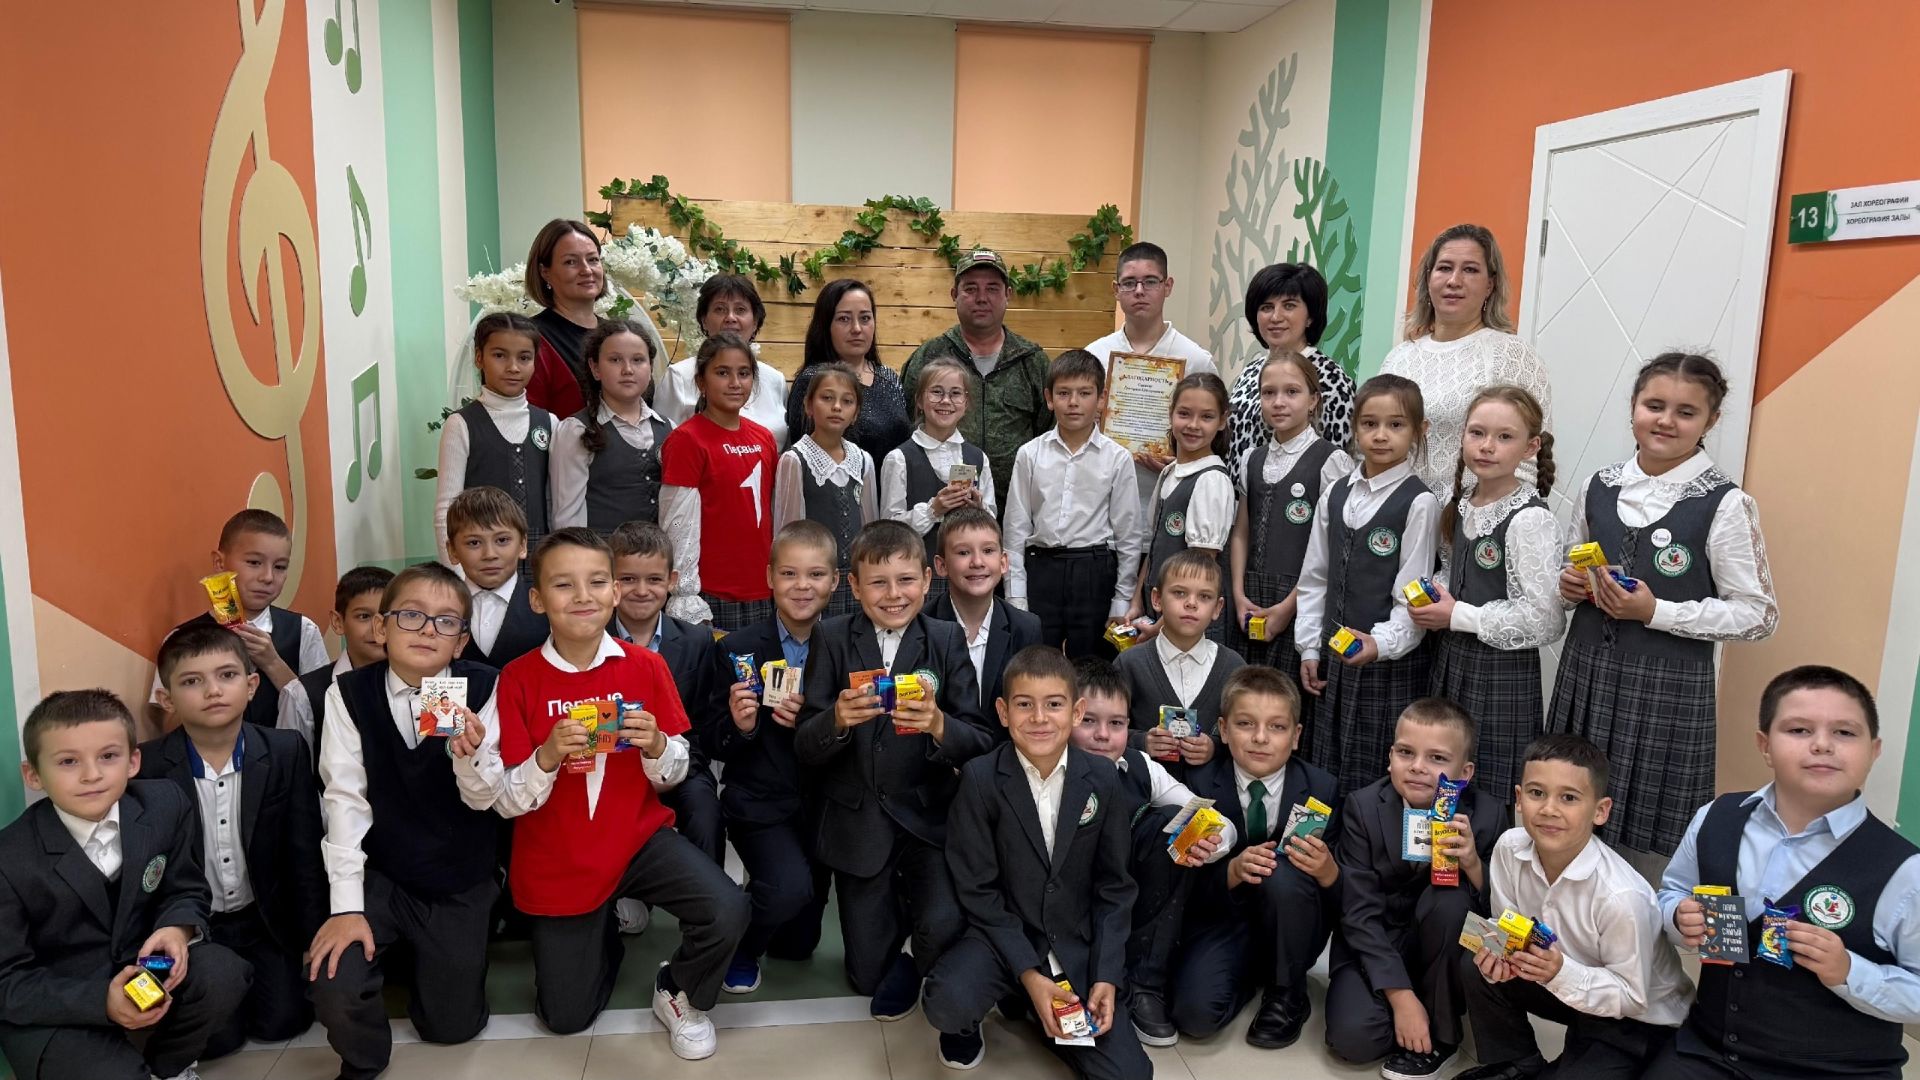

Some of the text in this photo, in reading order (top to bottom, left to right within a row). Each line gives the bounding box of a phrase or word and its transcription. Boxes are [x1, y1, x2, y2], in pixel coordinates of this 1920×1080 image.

[1863, 196, 1909, 207] ХОРЕОГРАФИИ
[1798, 206, 1818, 228] 13
[1846, 213, 1911, 225] ХОРЕОГРАФИЯ ЗАЛЫ
[723, 443, 762, 456] Первые
